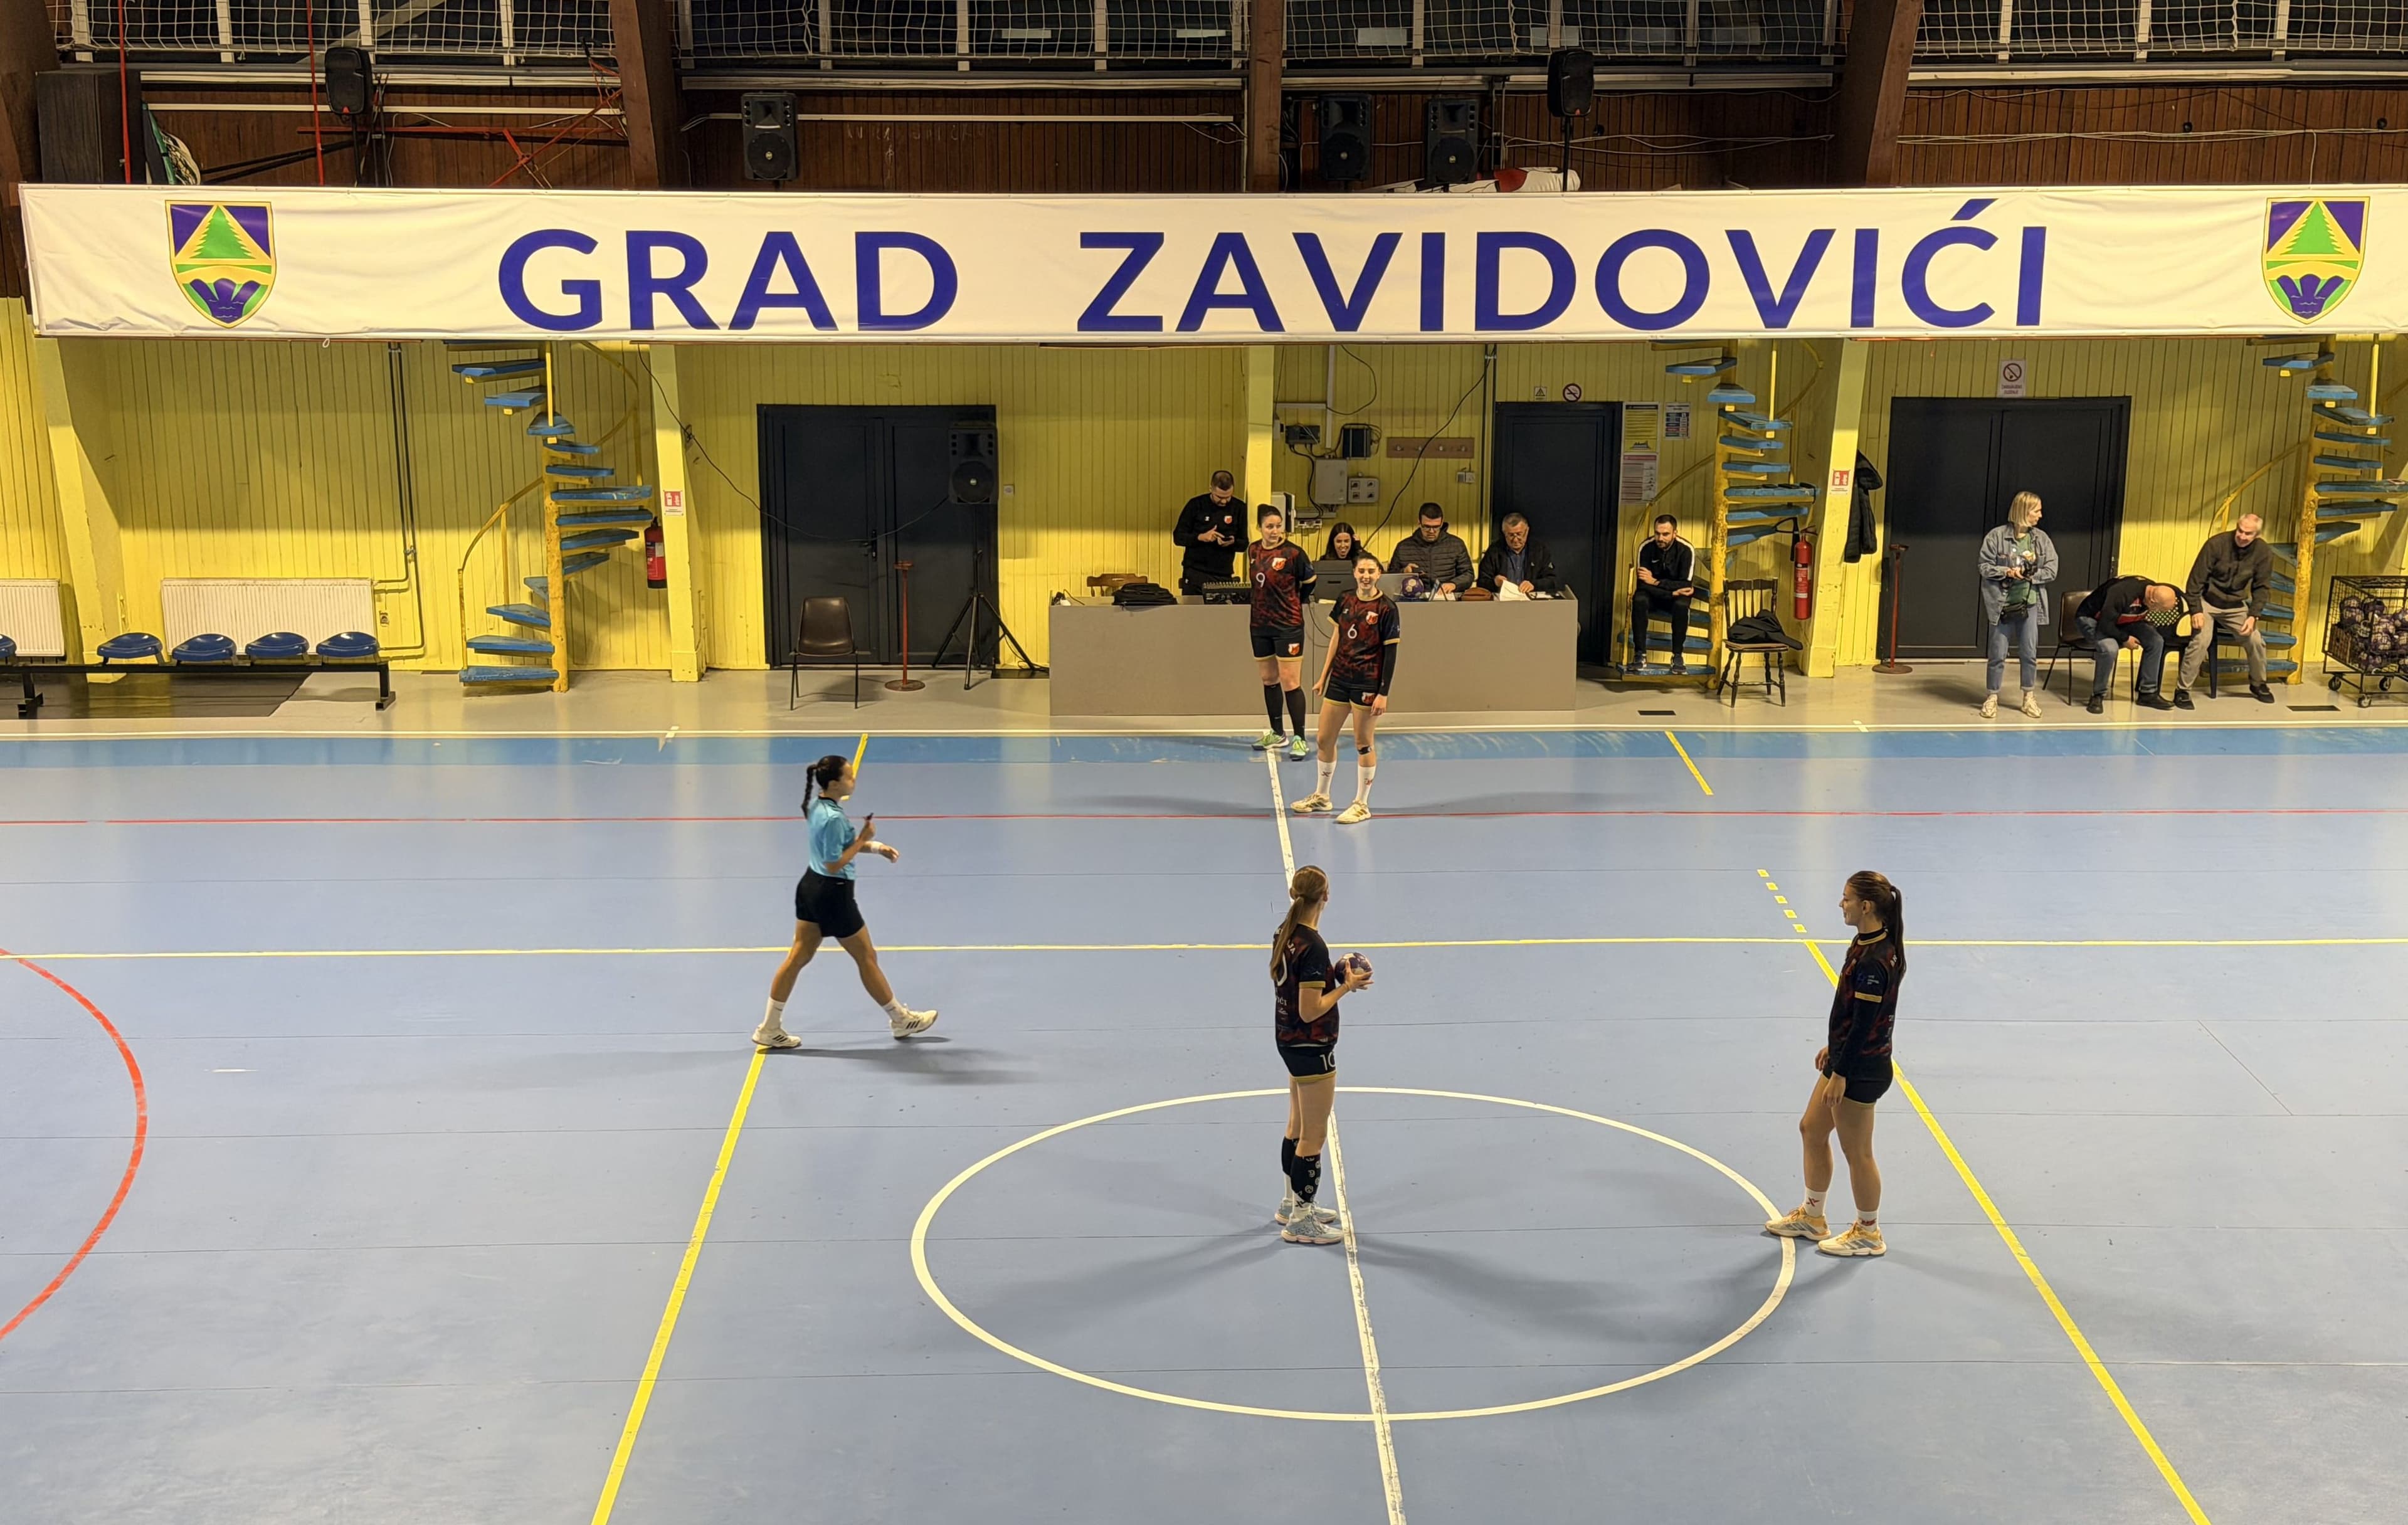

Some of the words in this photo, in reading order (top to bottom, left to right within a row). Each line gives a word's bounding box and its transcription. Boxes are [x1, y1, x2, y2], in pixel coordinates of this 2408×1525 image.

[499, 229, 958, 331] GRAD
[1077, 198, 2046, 332] ZAVIDOVIĆI
[1256, 572, 1265, 587] 9
[1348, 624, 1357, 638] 6
[1320, 1052, 1335, 1070] 10
